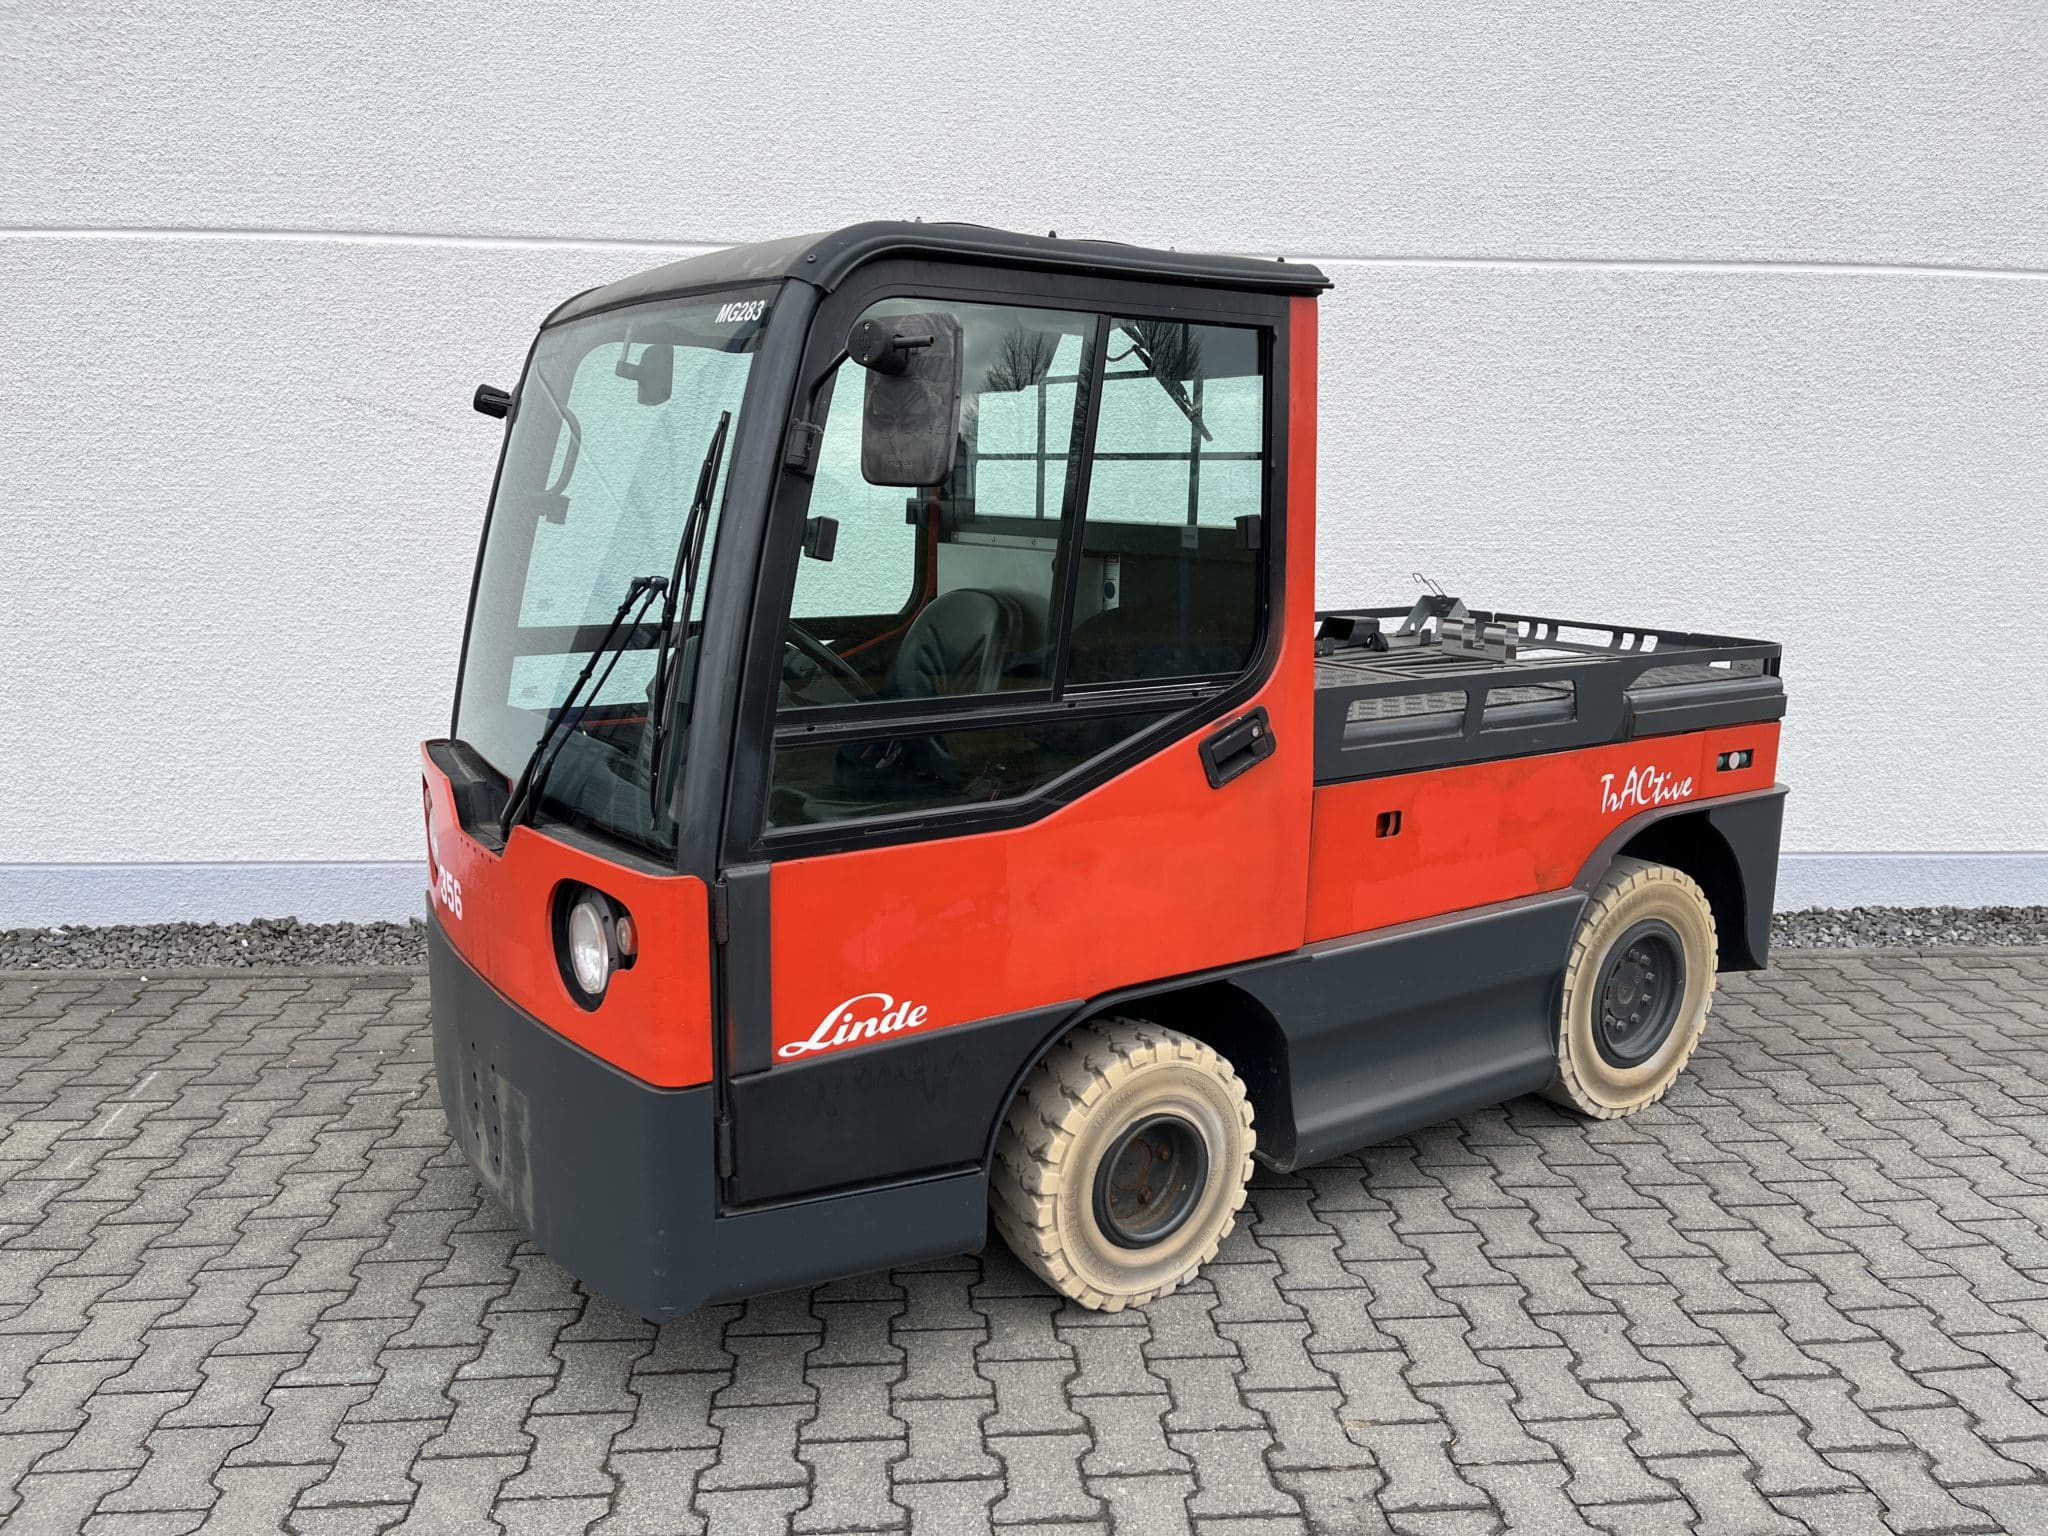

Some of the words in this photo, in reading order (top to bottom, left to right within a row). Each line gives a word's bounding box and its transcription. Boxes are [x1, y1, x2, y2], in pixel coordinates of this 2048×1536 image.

[714, 300, 765, 323] MG283
[1600, 765, 1693, 814] TrACtive
[439, 864, 463, 921] 356
[778, 993, 928, 1057] Linde
